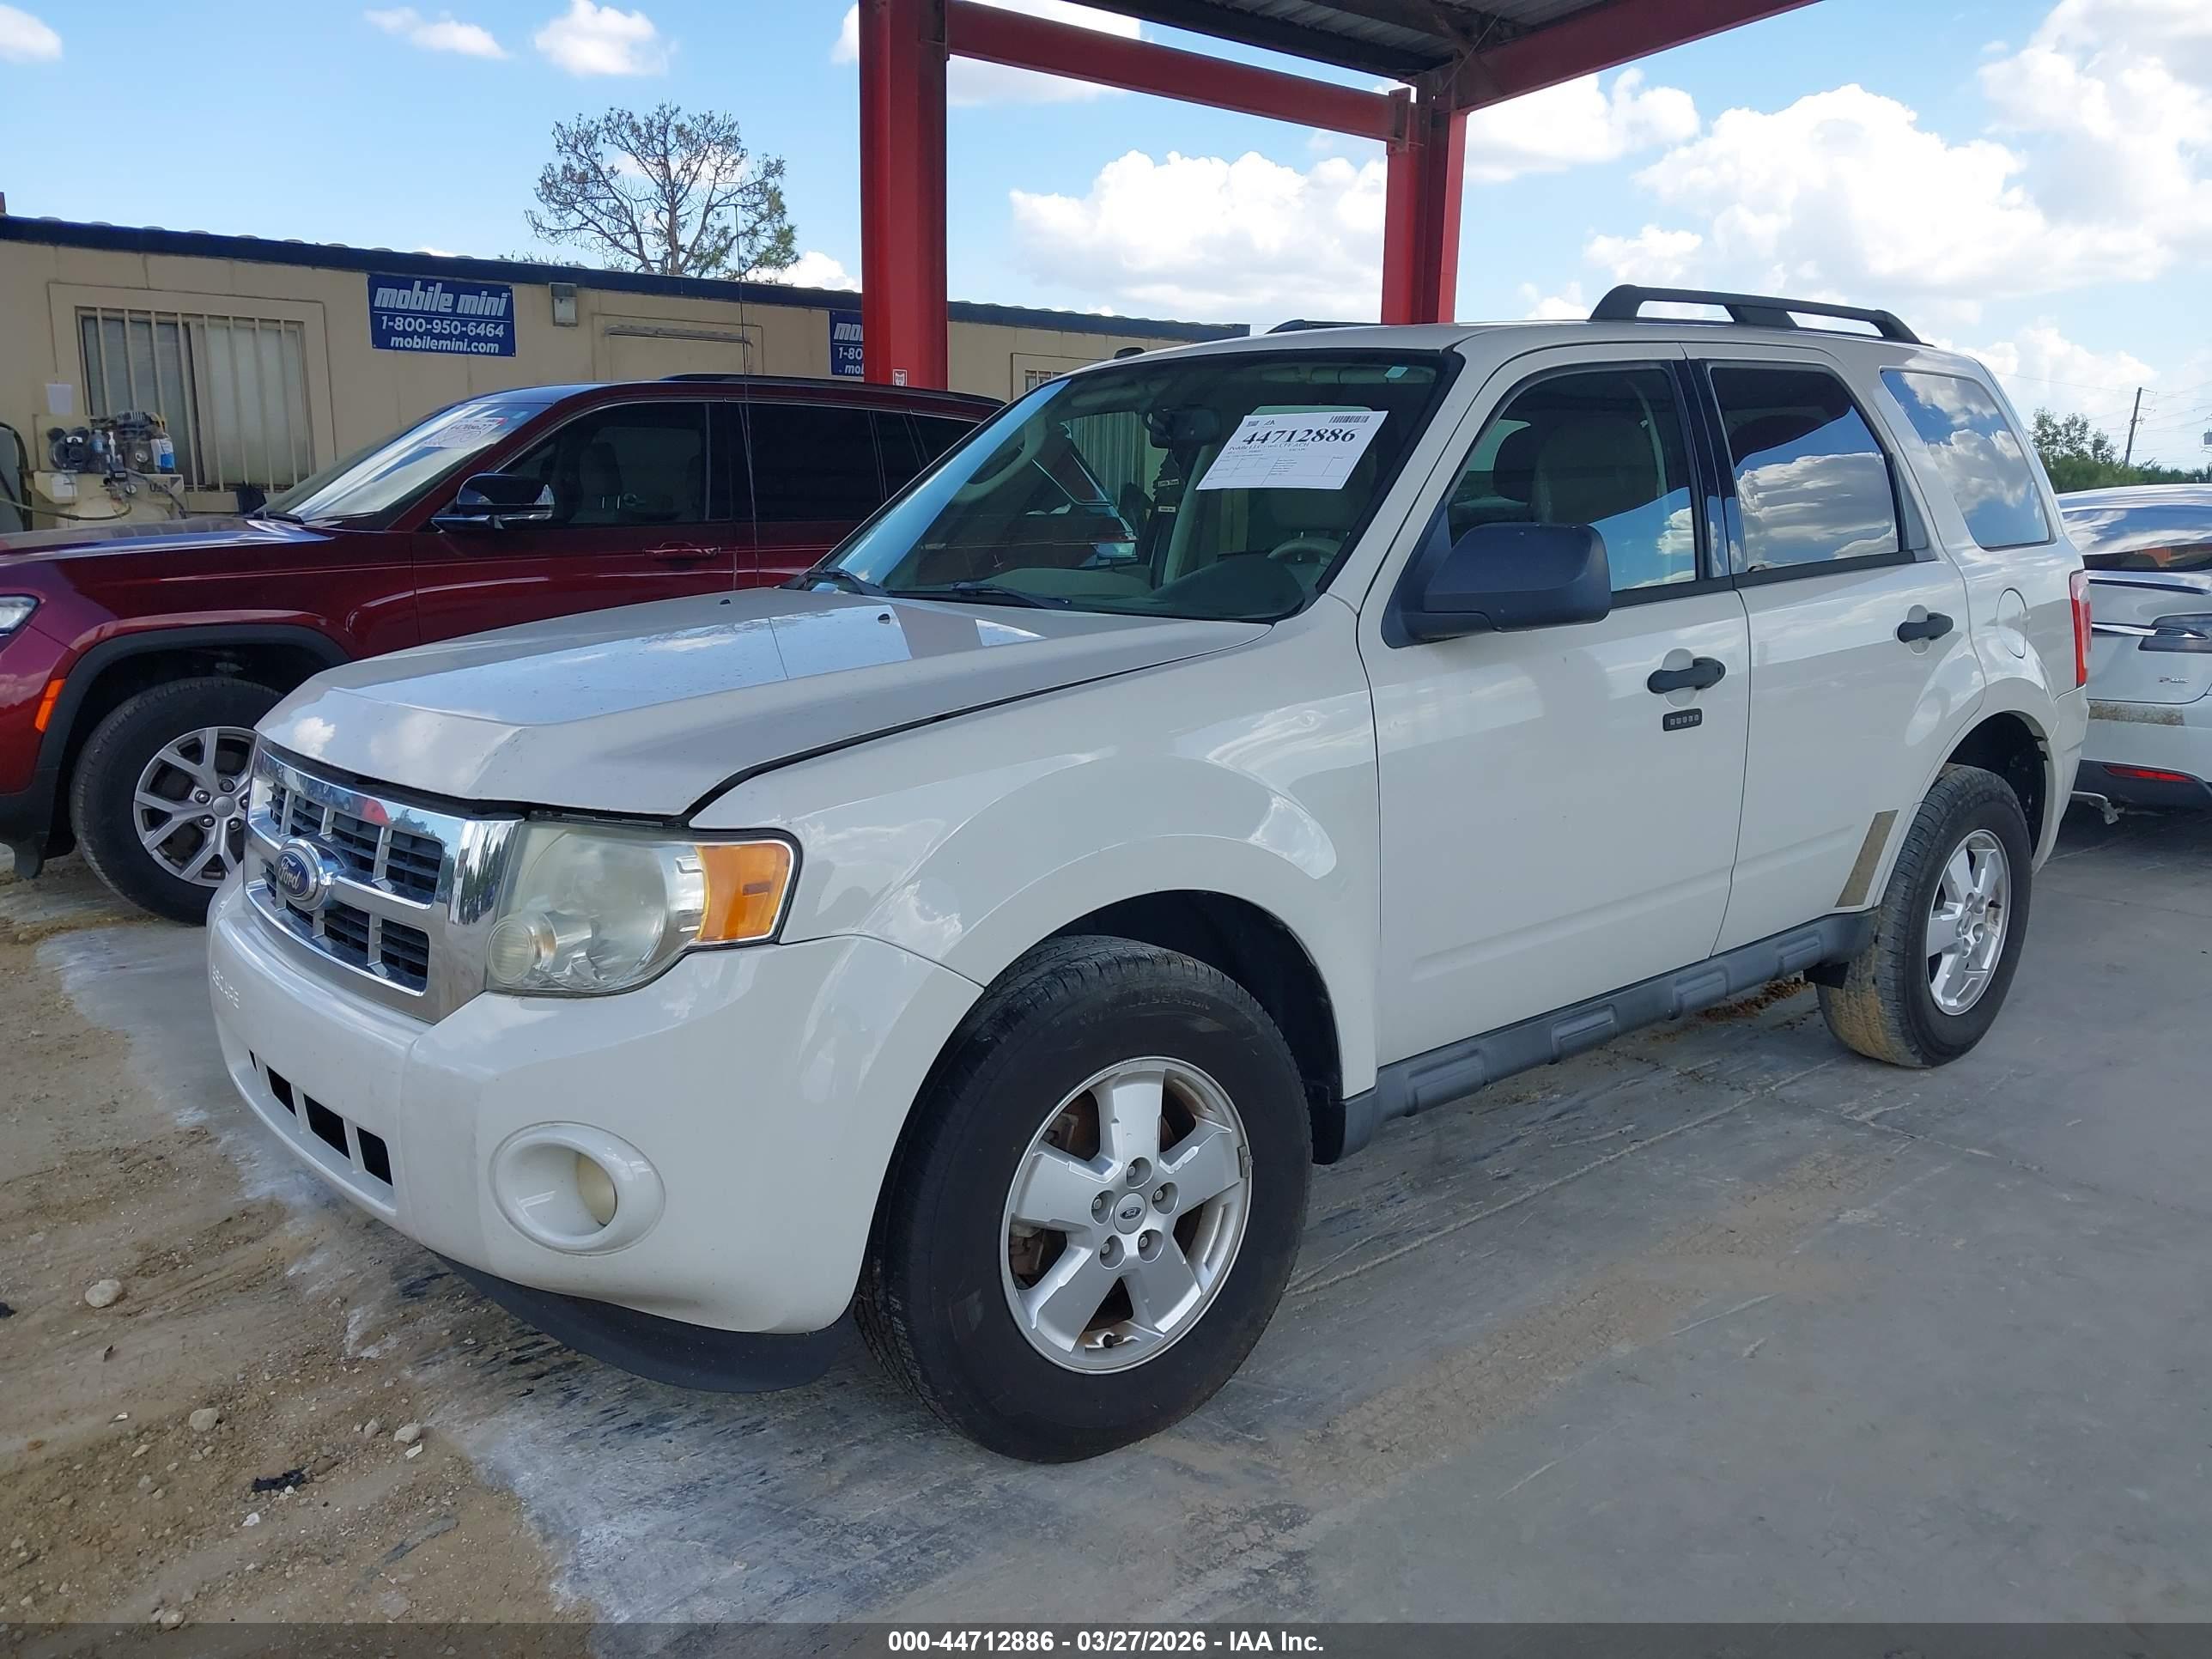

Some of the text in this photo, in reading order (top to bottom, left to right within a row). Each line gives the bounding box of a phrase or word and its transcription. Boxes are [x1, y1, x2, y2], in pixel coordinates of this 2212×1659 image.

[374, 280, 508, 317] mobile mini
[380, 315, 505, 337] 1-800-950-6464
[390, 335, 500, 354] mobilemini.com
[1243, 428, 1361, 445] 44712886
[277, 856, 301, 890] Ford
